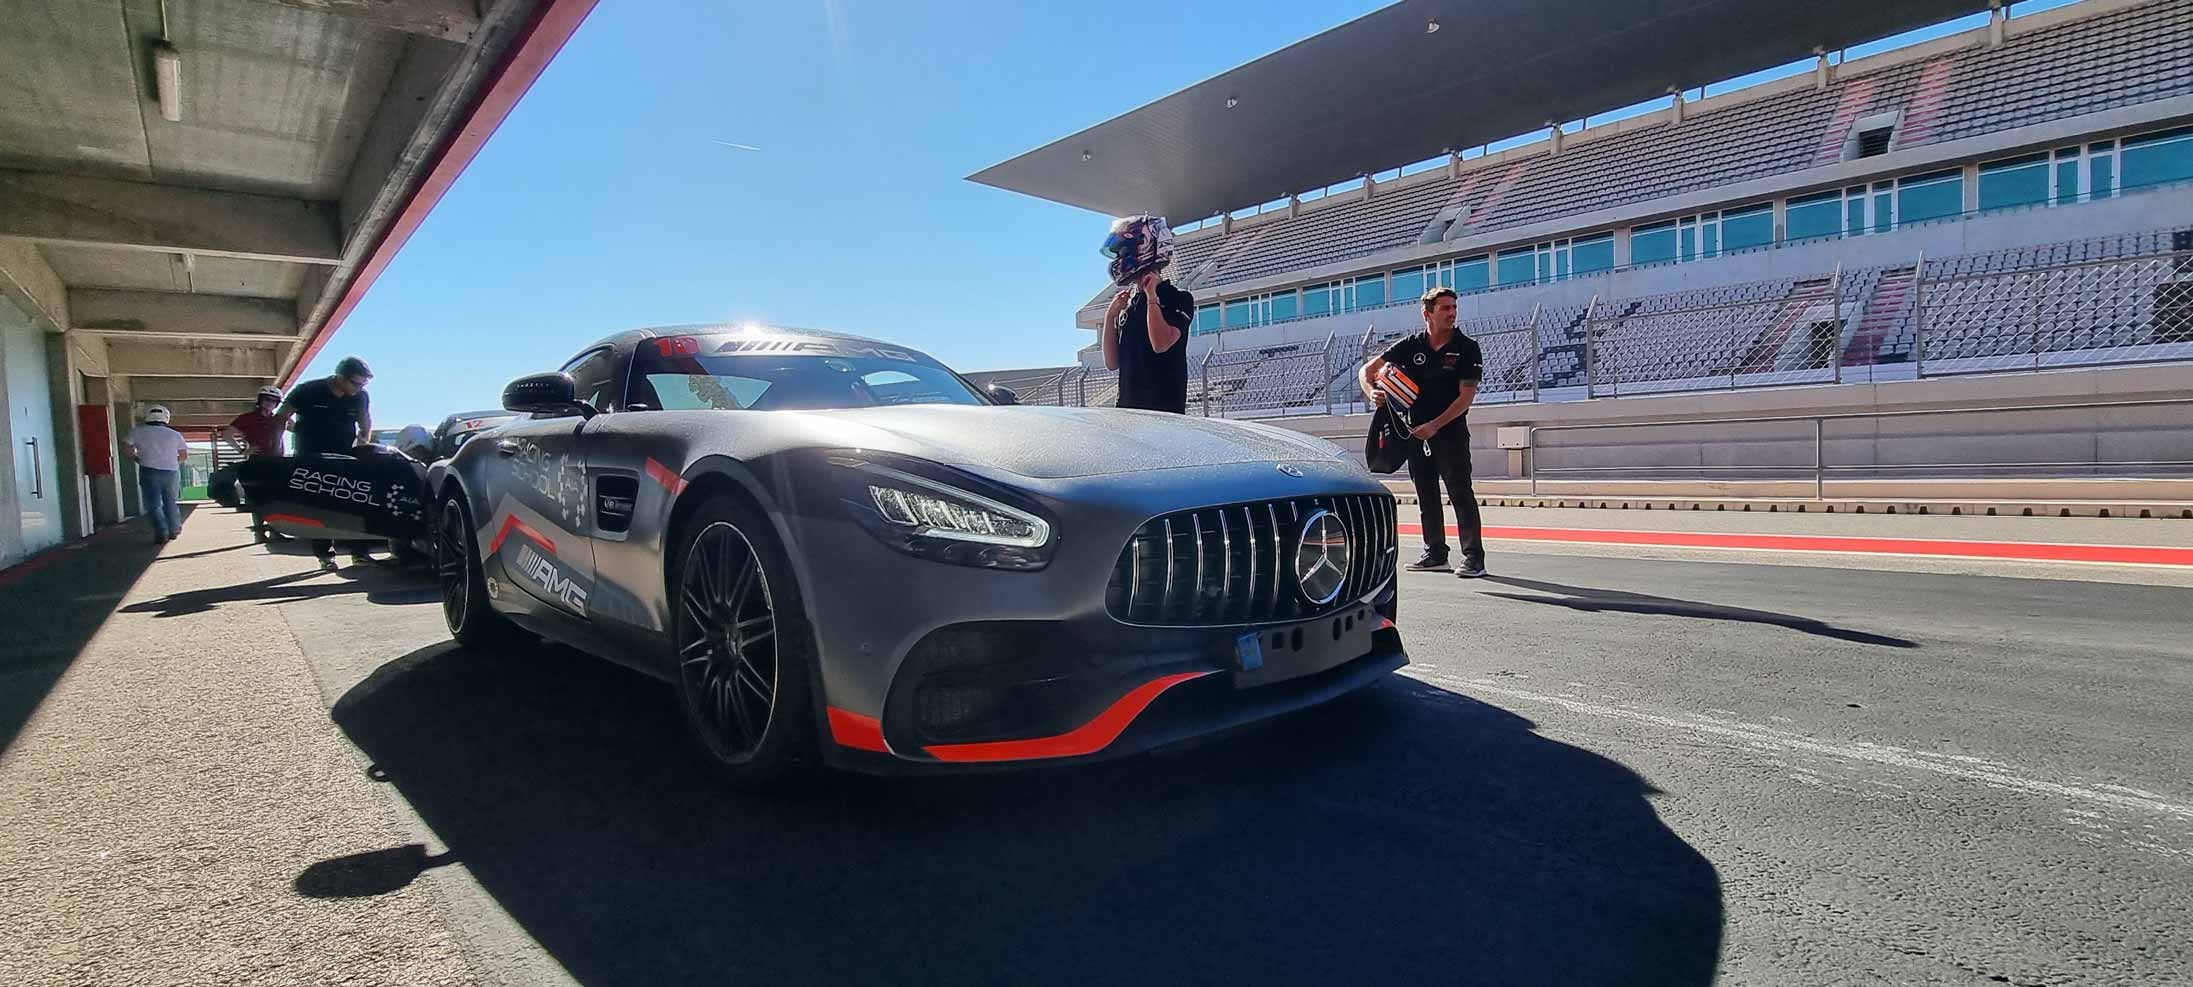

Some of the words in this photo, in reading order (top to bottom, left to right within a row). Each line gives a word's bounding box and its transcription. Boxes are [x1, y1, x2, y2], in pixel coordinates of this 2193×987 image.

[465, 420, 482, 429] 12
[288, 478, 381, 507] SCHOOL
[292, 467, 372, 492] RACING
[531, 558, 588, 617] AMG
